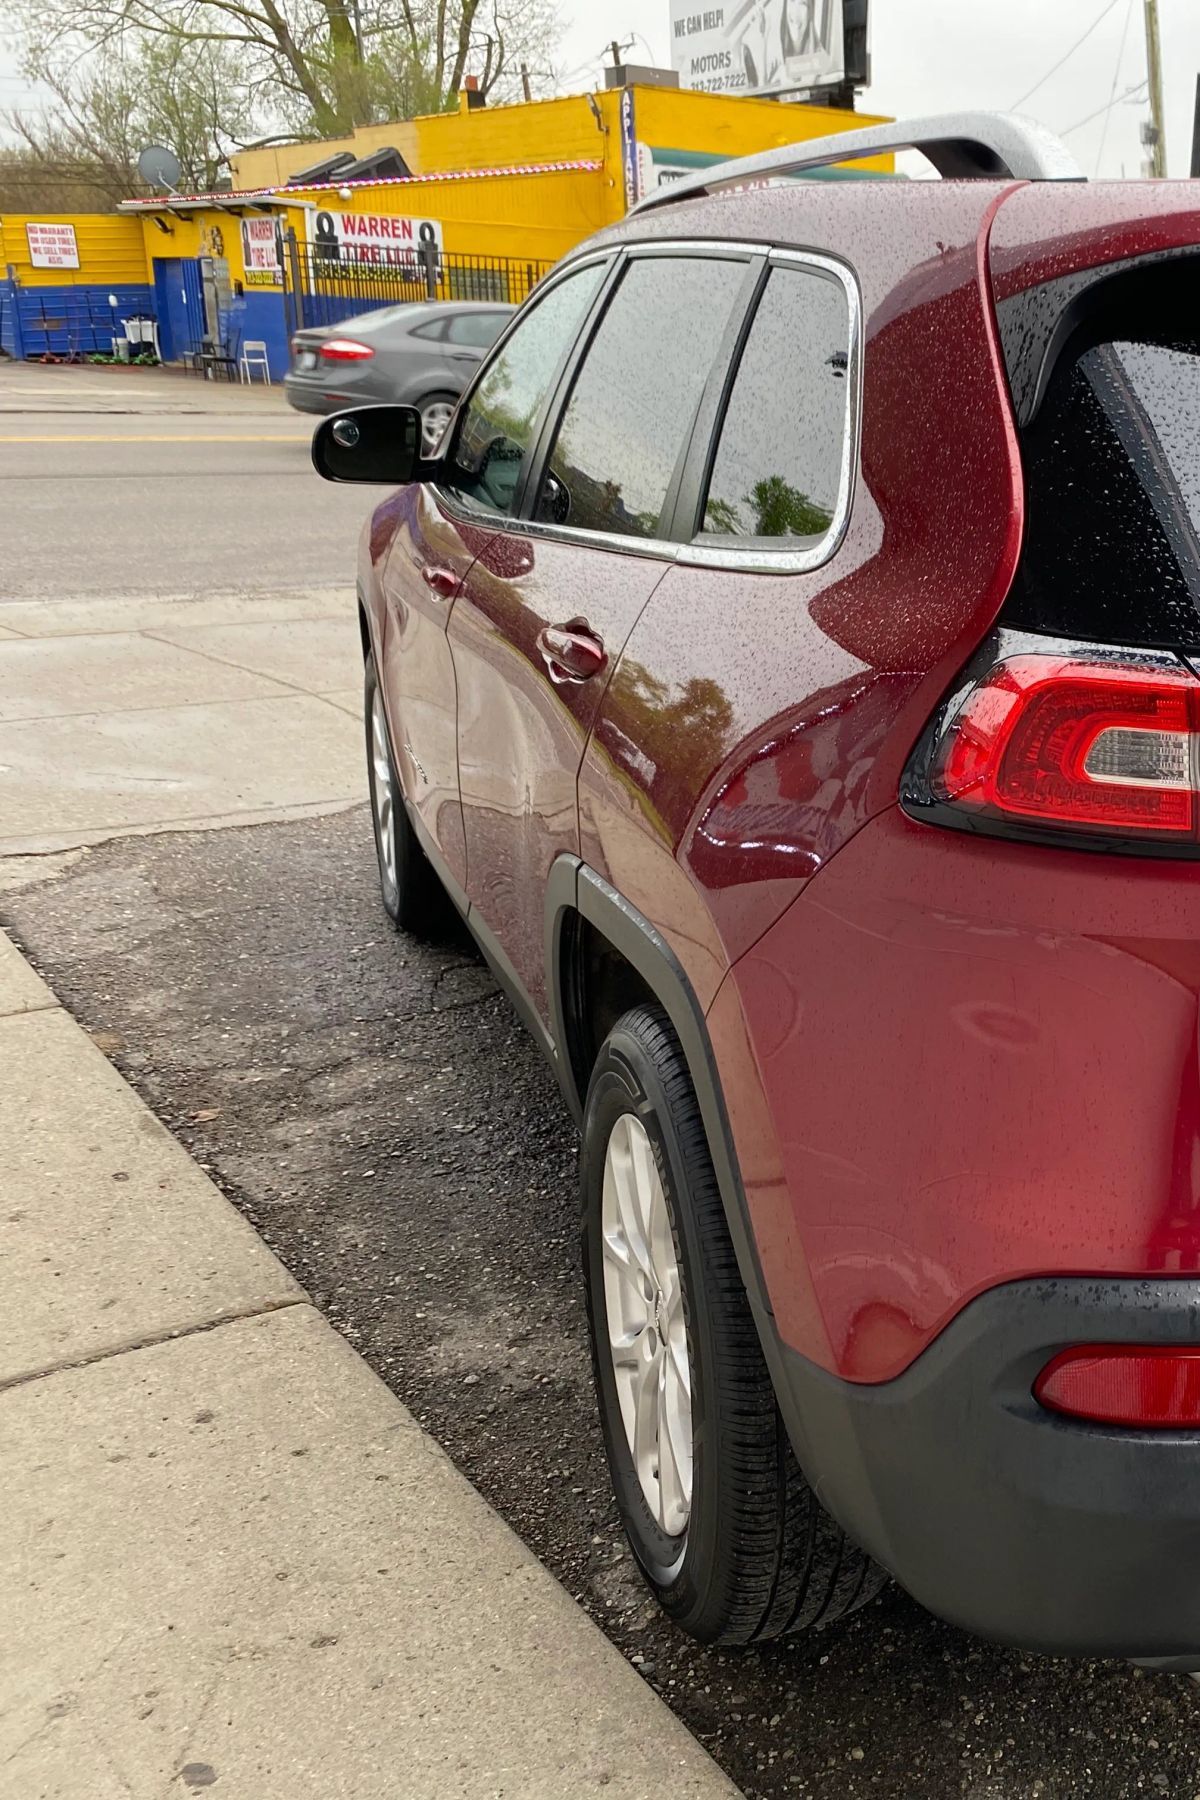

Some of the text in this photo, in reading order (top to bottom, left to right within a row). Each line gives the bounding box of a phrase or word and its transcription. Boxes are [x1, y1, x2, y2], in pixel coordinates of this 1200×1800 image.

[674, 8, 724, 38] WE CAN HELP!
[690, 51, 732, 76] MOTORS
[690, 72, 746, 92] 313-722-7222
[249, 220, 273, 241] WARREN
[341, 213, 413, 240] WARREN
[342, 241, 380, 264] TIRE
